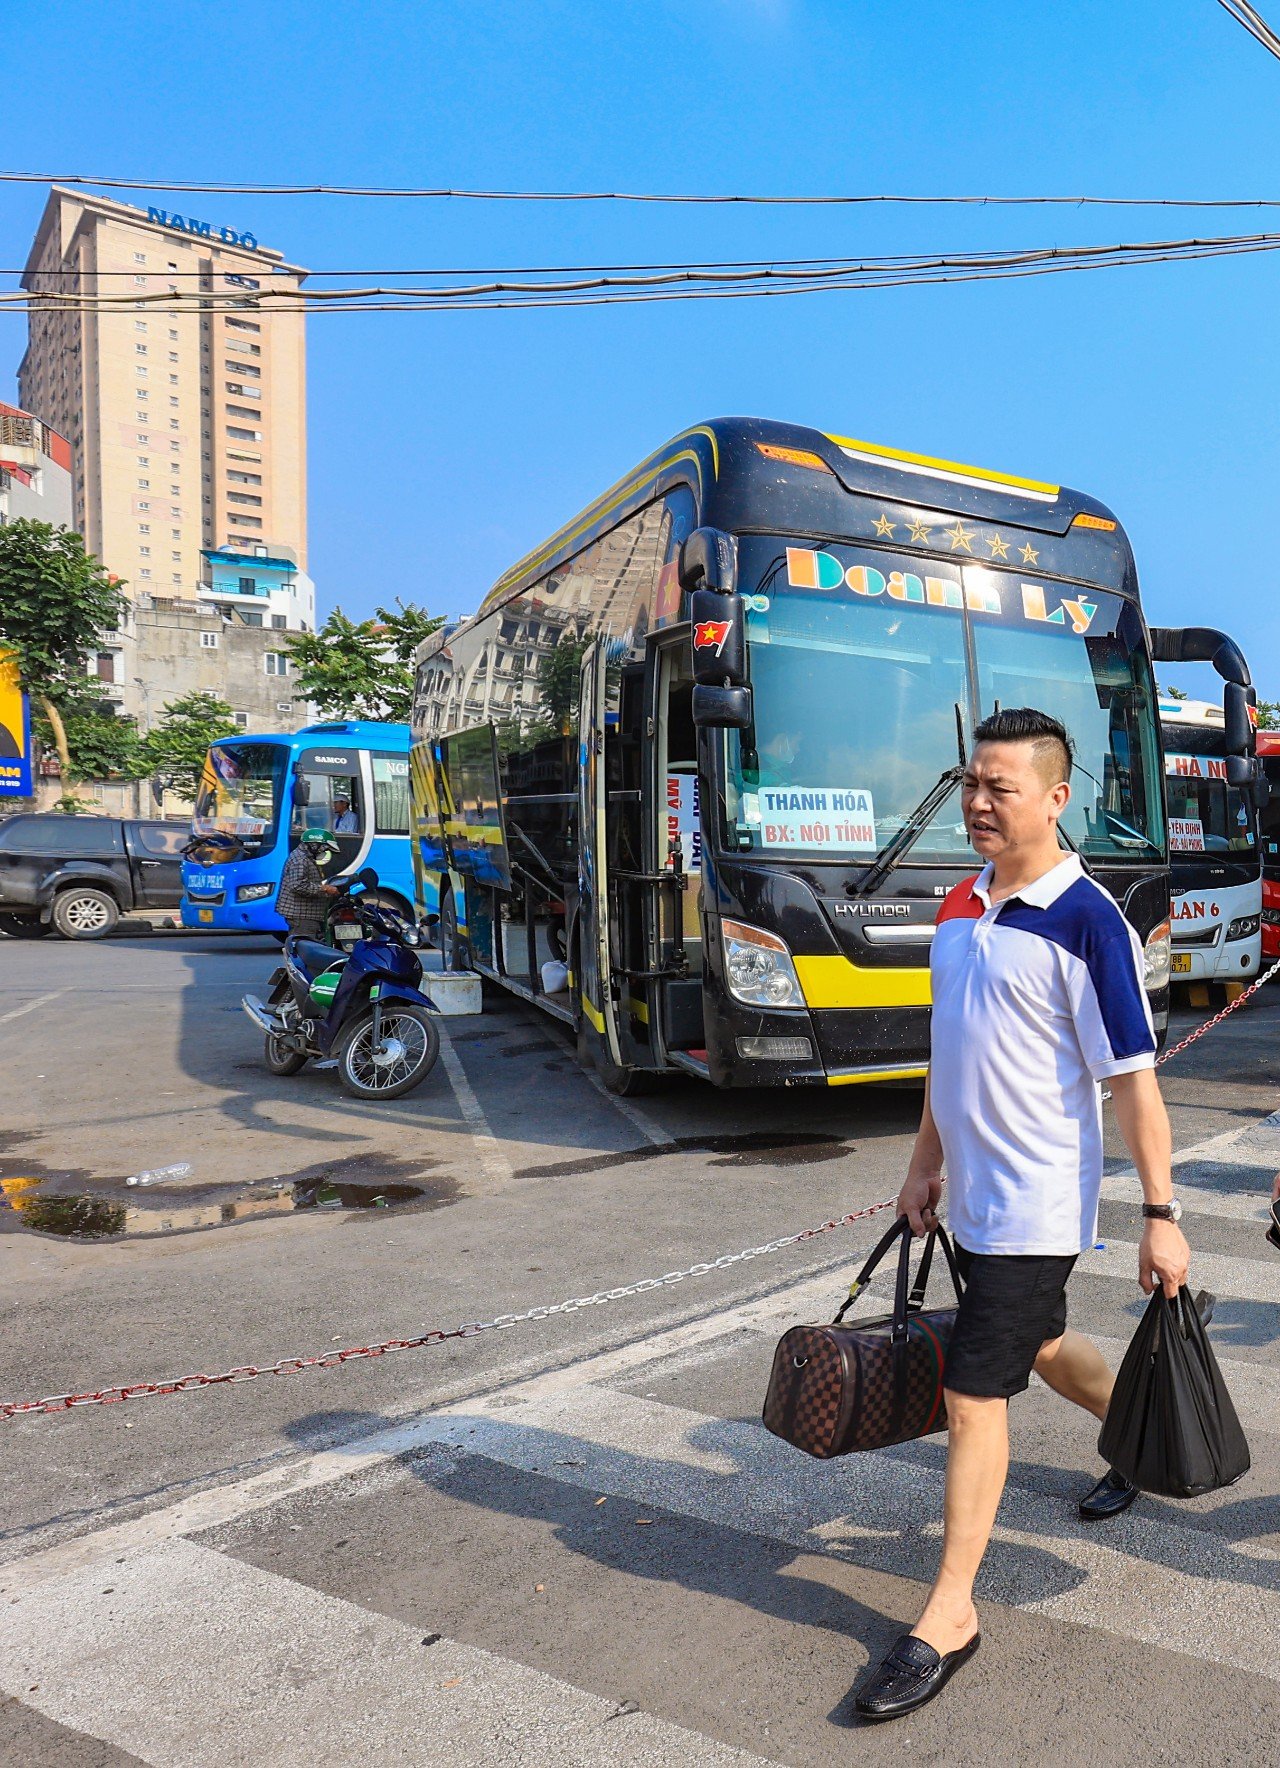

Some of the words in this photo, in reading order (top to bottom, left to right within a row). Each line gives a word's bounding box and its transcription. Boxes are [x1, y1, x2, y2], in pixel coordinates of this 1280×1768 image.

[148, 206, 211, 238] NAM
[220, 227, 258, 251] ĐÔ
[1021, 583, 1098, 634] Lý
[315, 755, 348, 765] SAMCO
[1175, 755, 1201, 777] HÀ
[765, 793, 827, 811] THANH
[832, 791, 868, 811] HÓA
[765, 825, 795, 843] BX:
[801, 821, 830, 846] NỘI
[835, 819, 873, 842] TỈNH
[934, 886, 944, 896] BX
[834, 904, 911, 918] HYUNDAI
[1170, 901, 1206, 919] LAN
[1210, 902, 1220, 917] 6
